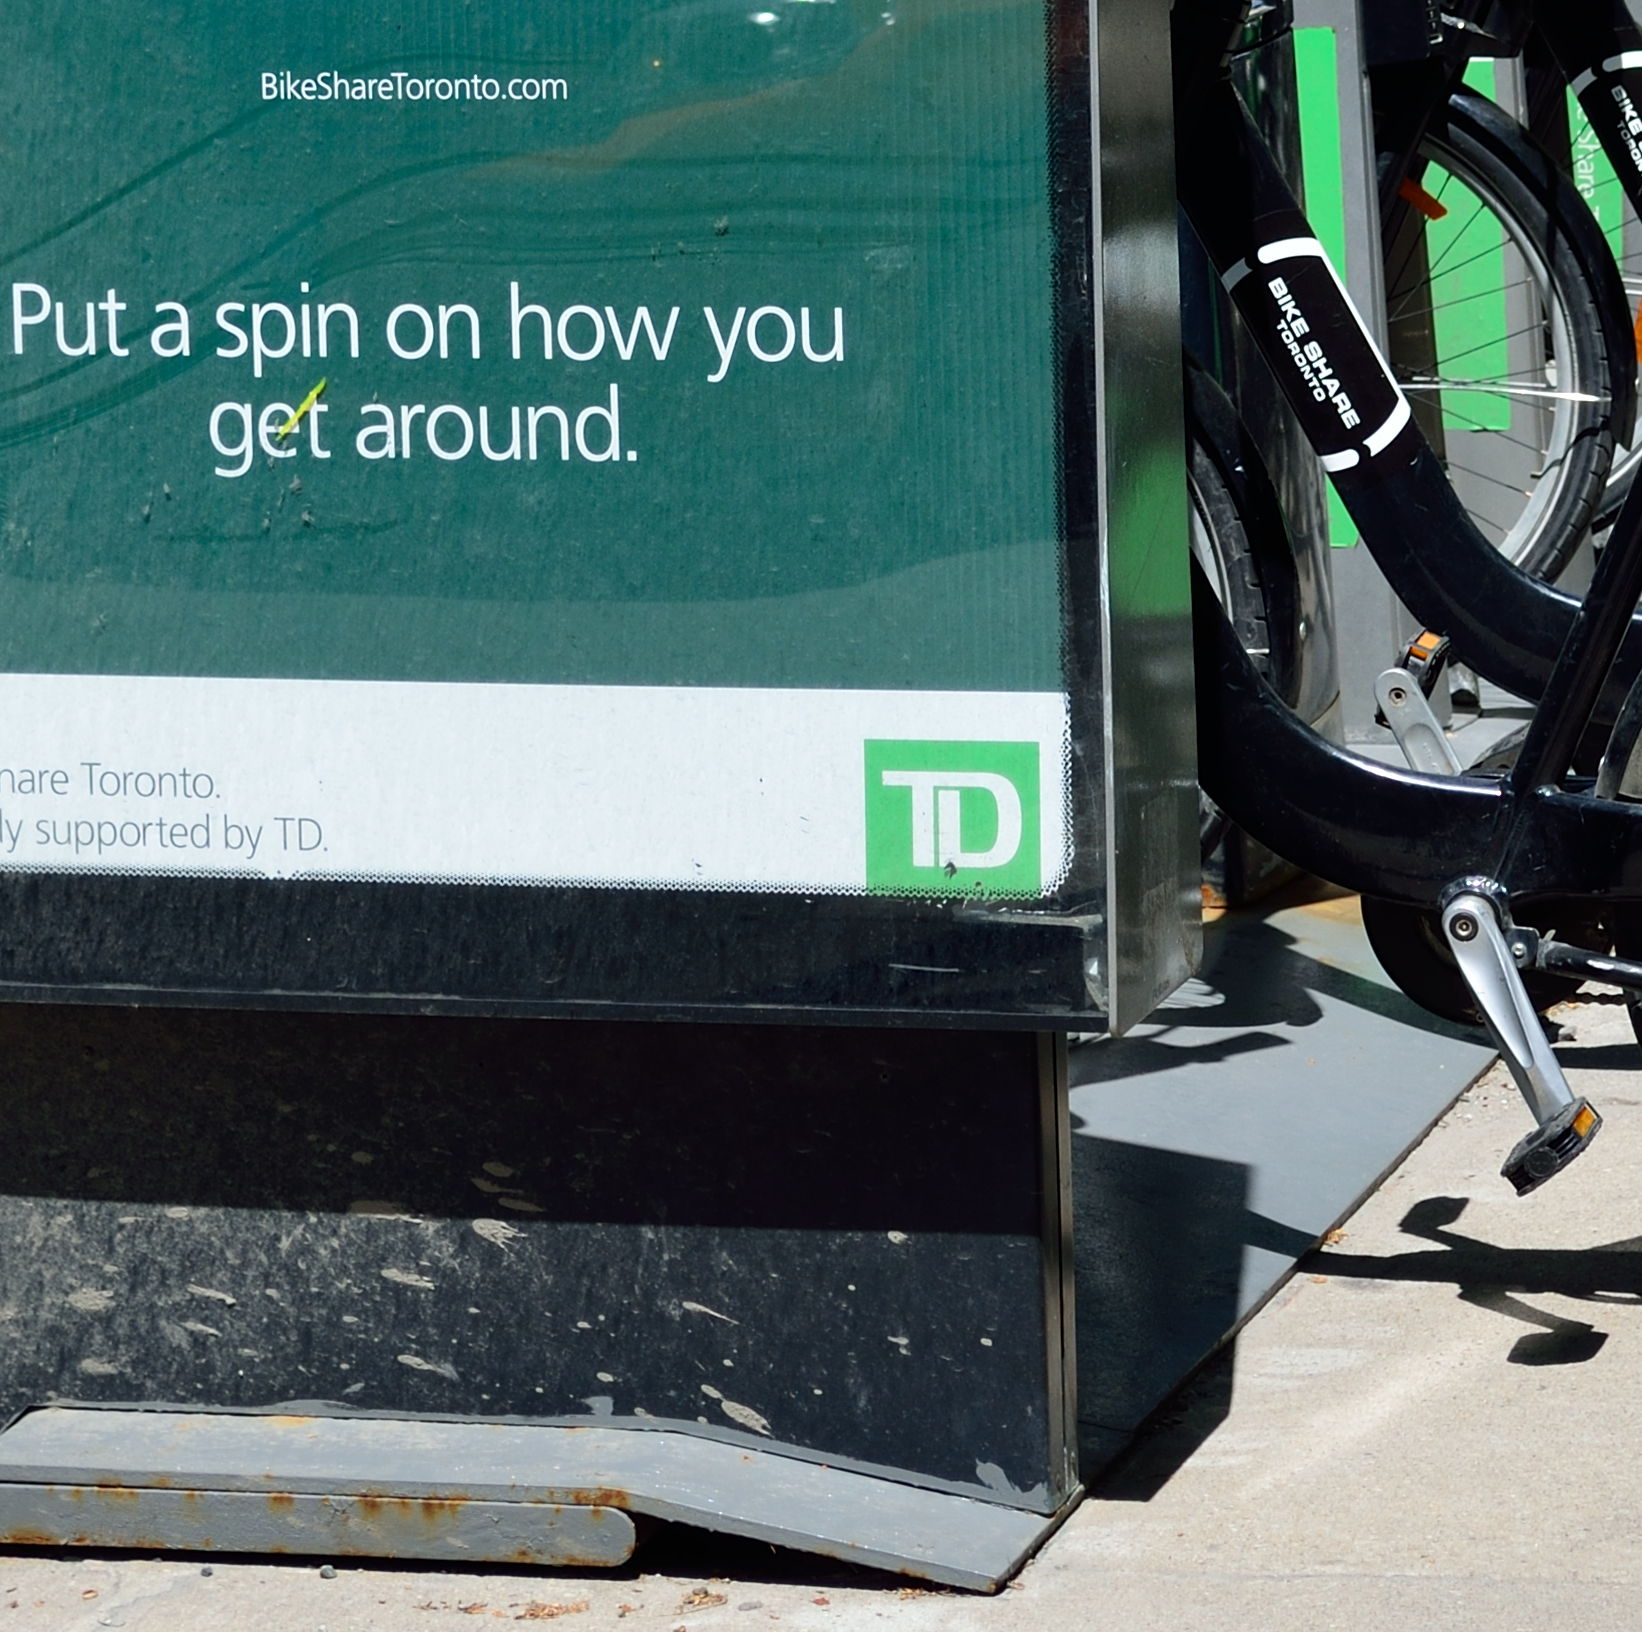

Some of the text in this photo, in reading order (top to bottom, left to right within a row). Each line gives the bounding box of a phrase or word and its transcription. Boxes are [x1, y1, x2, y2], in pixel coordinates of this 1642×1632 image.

[261, 70, 568, 100] BikeShareToronto.com
[10, 281, 845, 383] Put a spin on how you
[1268, 276, 1361, 430] BIKE SHARE
[1277, 319, 1326, 402] TORONTO
[209, 383, 638, 478] get around.
[80, 762, 221, 799] Toronto.
[882, 770, 1022, 868] TD
[36, 814, 211, 855] supported
[223, 814, 263, 859] by
[274, 817, 329, 852] TD.
